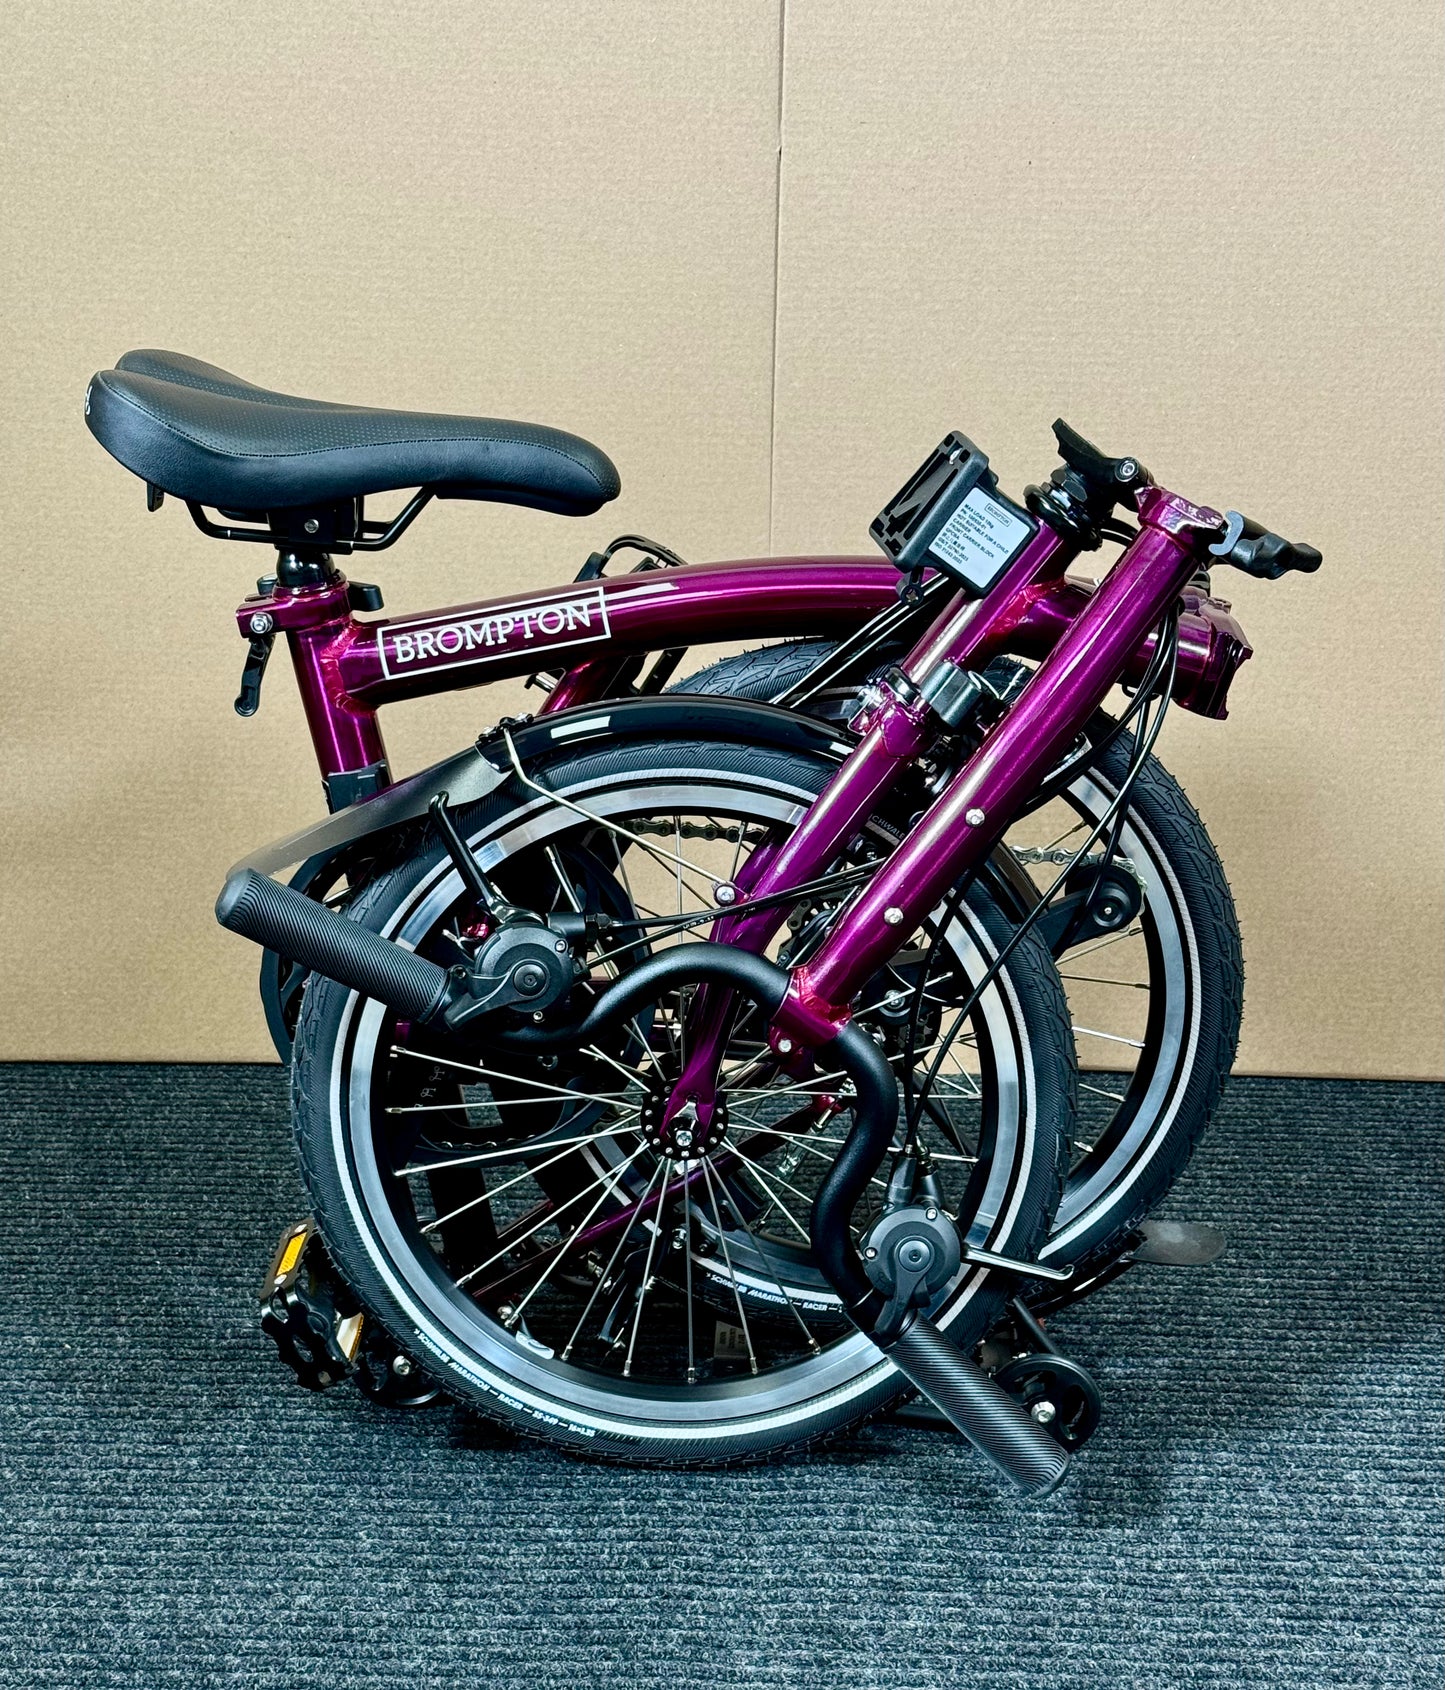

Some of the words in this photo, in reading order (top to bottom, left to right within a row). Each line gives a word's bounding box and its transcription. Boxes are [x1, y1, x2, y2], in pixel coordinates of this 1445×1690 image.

[953, 518, 971, 533] CARRIER
[964, 503, 974, 512] MAX
[974, 510, 985, 520] LOAD
[949, 522, 963, 534] FRONT
[963, 533, 981, 548] CARRIER
[980, 546, 994, 558] BLOCK
[957, 513, 966, 521] NOT
[966, 520, 984, 535] SUITABLE
[984, 534, 993, 542] FOR
[996, 543, 1009, 554] CHILD
[393, 602, 591, 663] BROMPTON
[802, 1301, 827, 1311] RACER
[418, 1332, 450, 1363] SCHWALBE
[448, 1362, 490, 1391] MARATHON
[498, 1394, 524, 1410] RACER
